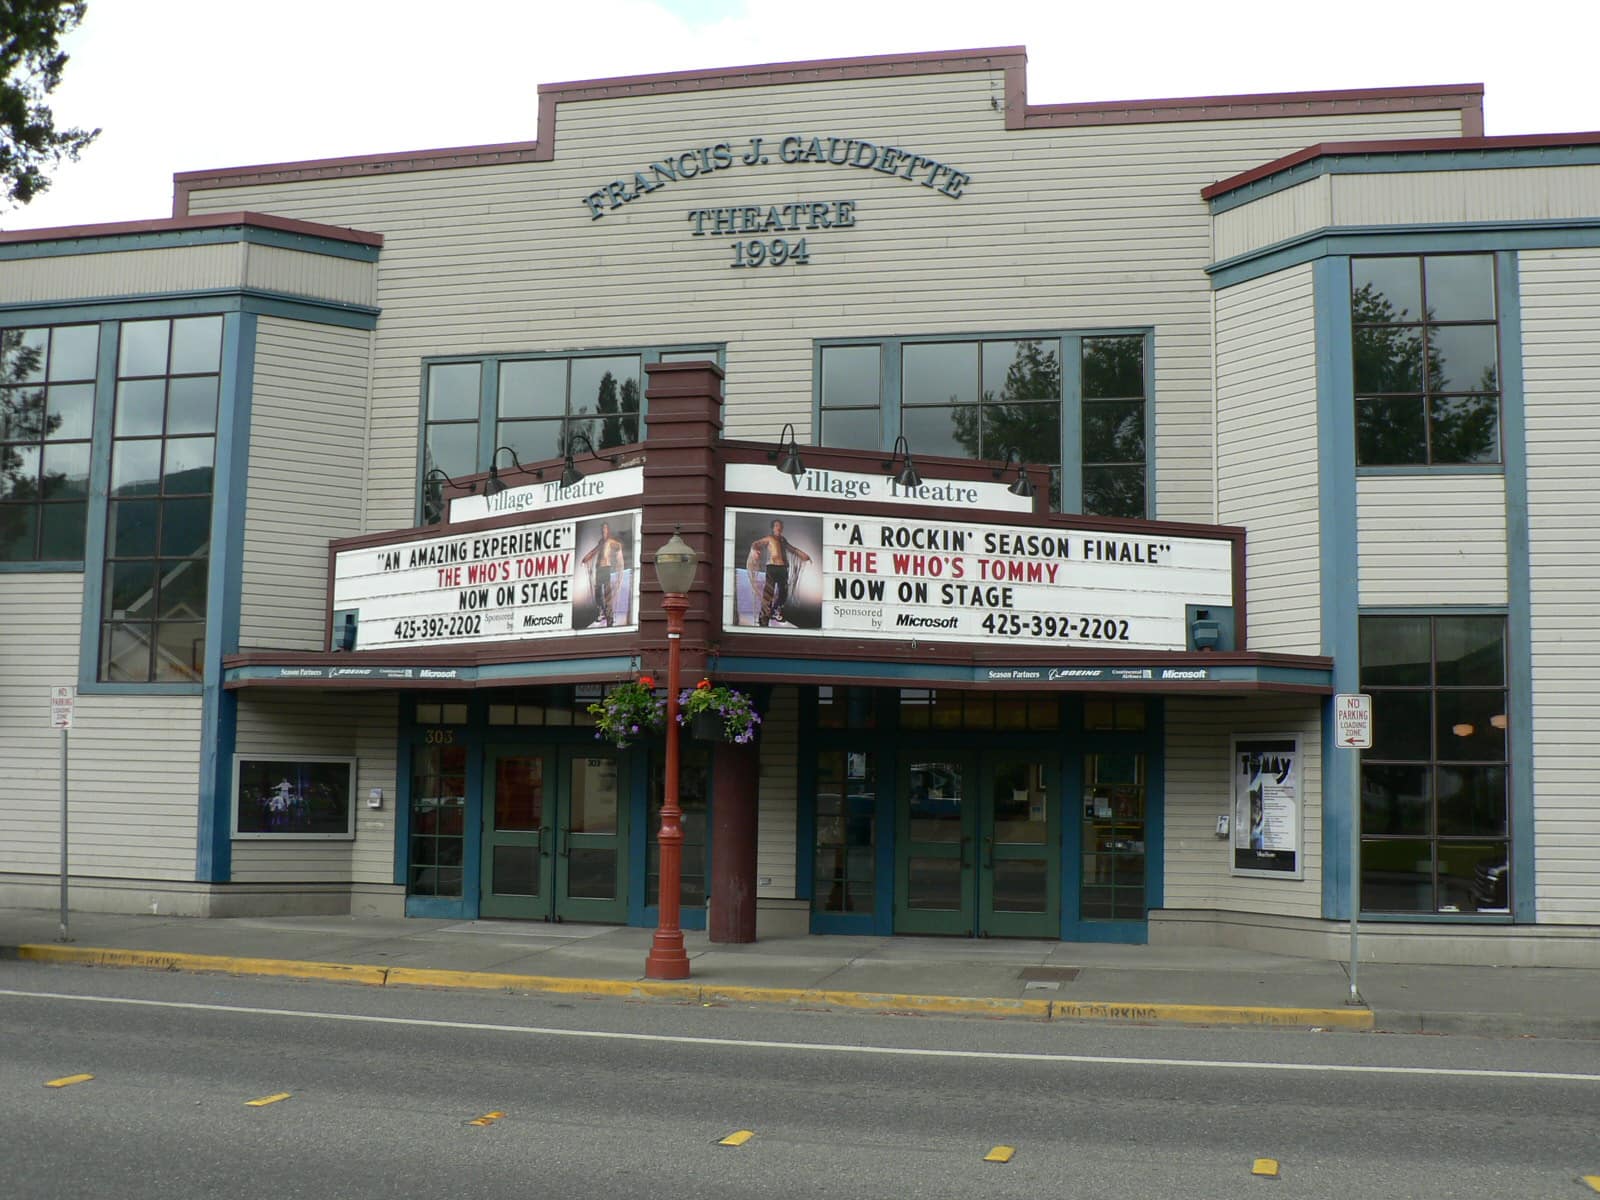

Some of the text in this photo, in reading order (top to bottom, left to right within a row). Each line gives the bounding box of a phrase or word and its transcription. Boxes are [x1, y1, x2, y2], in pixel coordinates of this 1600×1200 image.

[582, 136, 971, 221] FRANCIS J. GAUDETTE
[688, 201, 856, 236] THEATRE
[730, 238, 808, 268] 1994
[486, 479, 605, 513] Village Theatre
[791, 470, 978, 503] Village Theatre
[409, 542, 467, 568] AMAZING
[881, 526, 973, 550] ROCKIN'
[984, 533, 1069, 558] SEASON
[437, 553, 571, 588] THE WHO'S TOMMY
[834, 550, 1059, 584] THE WHO'S TOMMY
[459, 579, 568, 611] NOW ON STAGE
[834, 578, 1013, 608] NOW ON STAGE
[485, 612, 514, 624] Sponsored
[523, 613, 563, 628] Microsoft
[833, 605, 883, 618] Sponsored
[872, 618, 882, 629] by
[896, 614, 958, 629] Microsoft
[394, 614, 482, 640] 425-392-2202
[982, 613, 1129, 640] 425-392-2202
[420, 669, 456, 678] Microsoft
[988, 670, 1040, 679] Season Partners
[1162, 670, 1207, 679] Microsoft
[1339, 710, 1368, 720] PARKING
[1347, 699, 1360, 708] NO
[425, 730, 453, 744] 303
